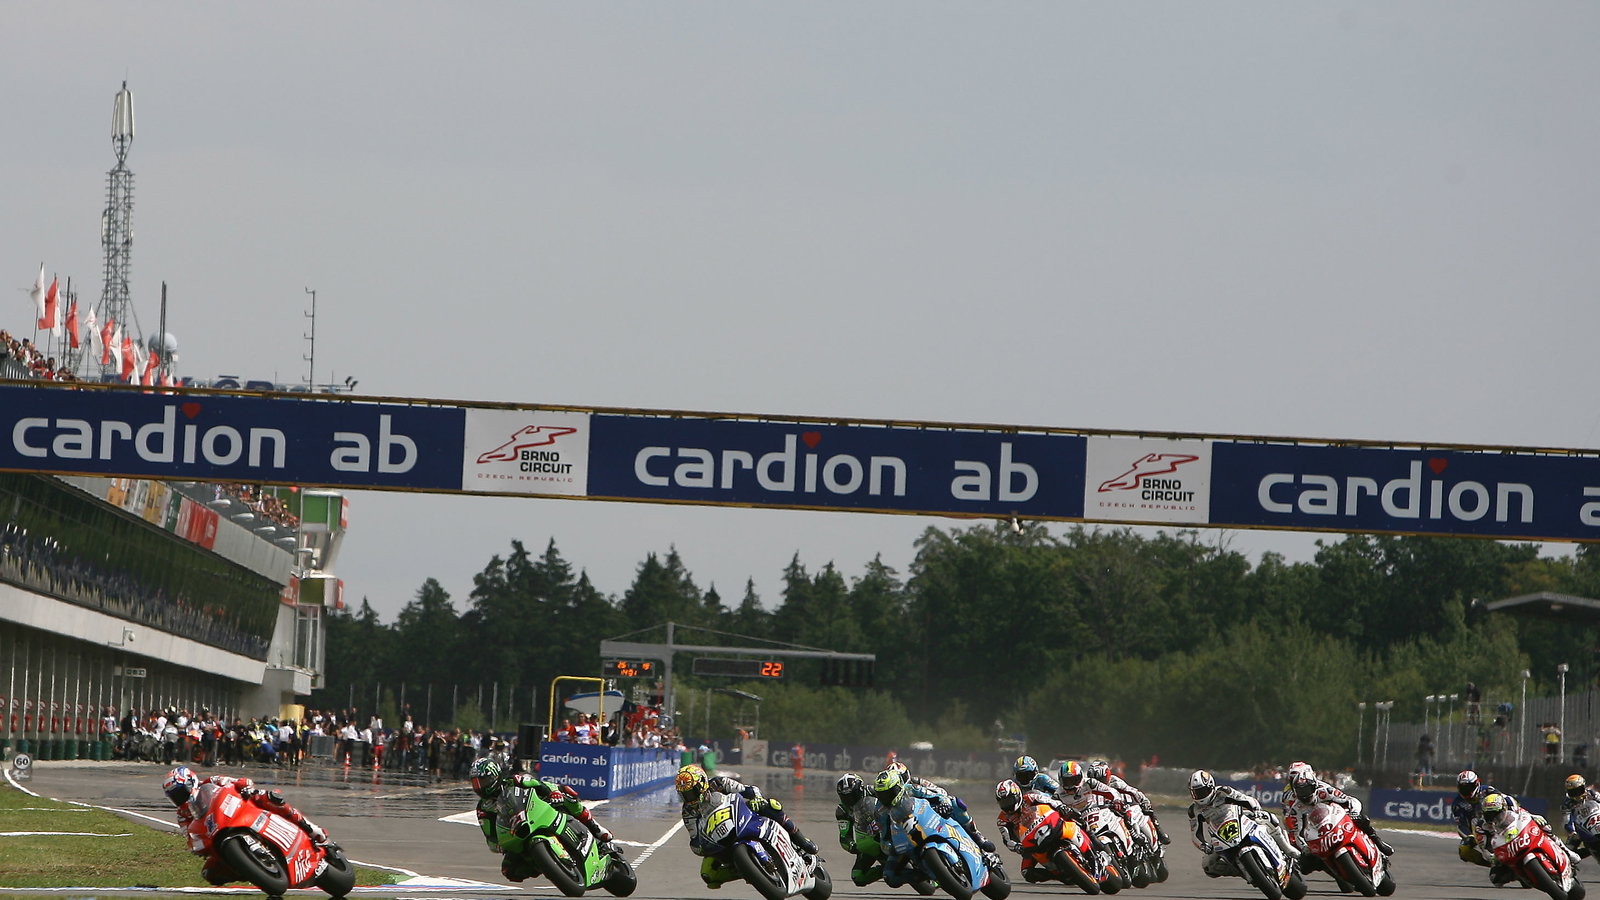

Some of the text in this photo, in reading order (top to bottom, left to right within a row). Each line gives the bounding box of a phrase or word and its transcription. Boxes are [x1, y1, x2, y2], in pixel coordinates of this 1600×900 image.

[12, 402, 418, 474] cardion ab
[521, 450, 560, 462] BRNO
[520, 462, 573, 474] CIRCUIT
[634, 431, 1039, 502] cardion ab
[519, 475, 574, 483] REPUBLIC
[1142, 478, 1182, 490] BRNO
[1141, 490, 1195, 502] CIRCUIT
[1257, 457, 1535, 523] cardion
[1140, 503, 1196, 511] REPUBLIC
[761, 662, 783, 677] 22
[16, 757, 29, 766] 60
[541, 752, 607, 766] cardion ab
[590, 776, 607, 788] ab
[706, 807, 731, 836] 46
